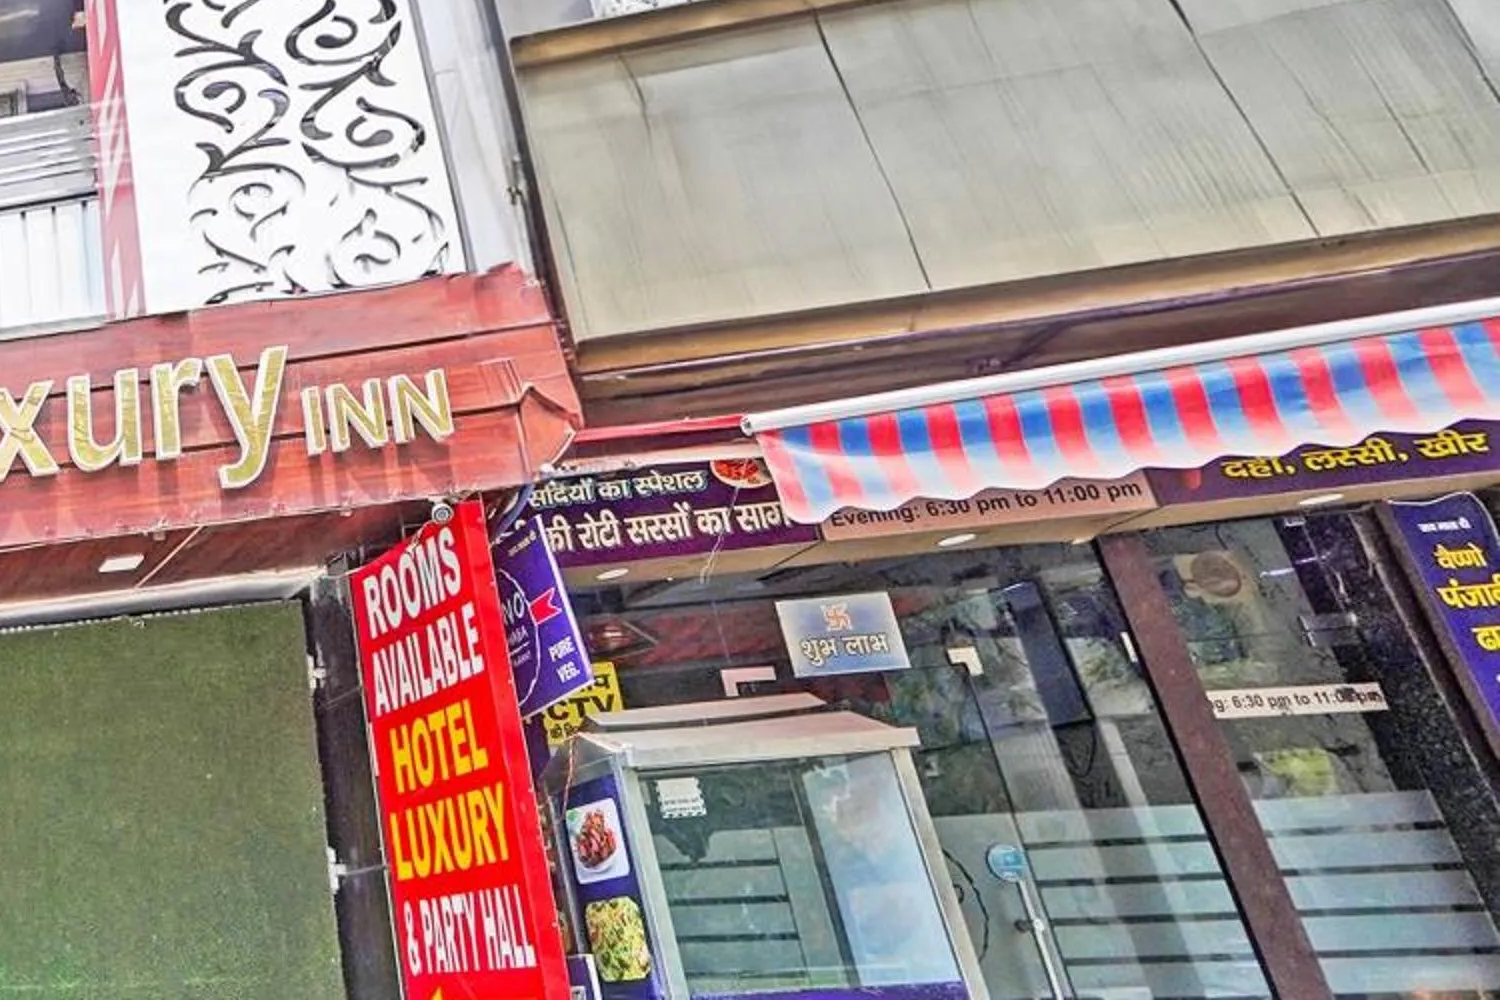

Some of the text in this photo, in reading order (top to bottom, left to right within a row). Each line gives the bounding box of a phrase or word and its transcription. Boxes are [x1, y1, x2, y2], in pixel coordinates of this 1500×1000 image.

[301, 368, 456, 456] INN
[599, 480, 630, 499] का
[634, 470, 706, 496] स्पेशल
[1301, 437, 1409, 471] लस्सी,
[1414, 430, 1490, 458] खीर
[576, 508, 622, 549] रोटी
[624, 502, 693, 543] सरसों
[694, 505, 732, 535] का
[831, 480, 1143, 528] Evening: 6:30 pm to 11:00 pm
[363, 524, 461, 640] ROOMS
[371, 602, 485, 716] AVAILABLE
[801, 634, 889, 668] शुभ लाभ
[1231, 694, 1264, 710] 6:30
[1293, 692, 1310, 706] to
[389, 697, 488, 795] HOTEL
[390, 782, 509, 882] LUXURY
[404, 884, 537, 977] & PARTY HALL
